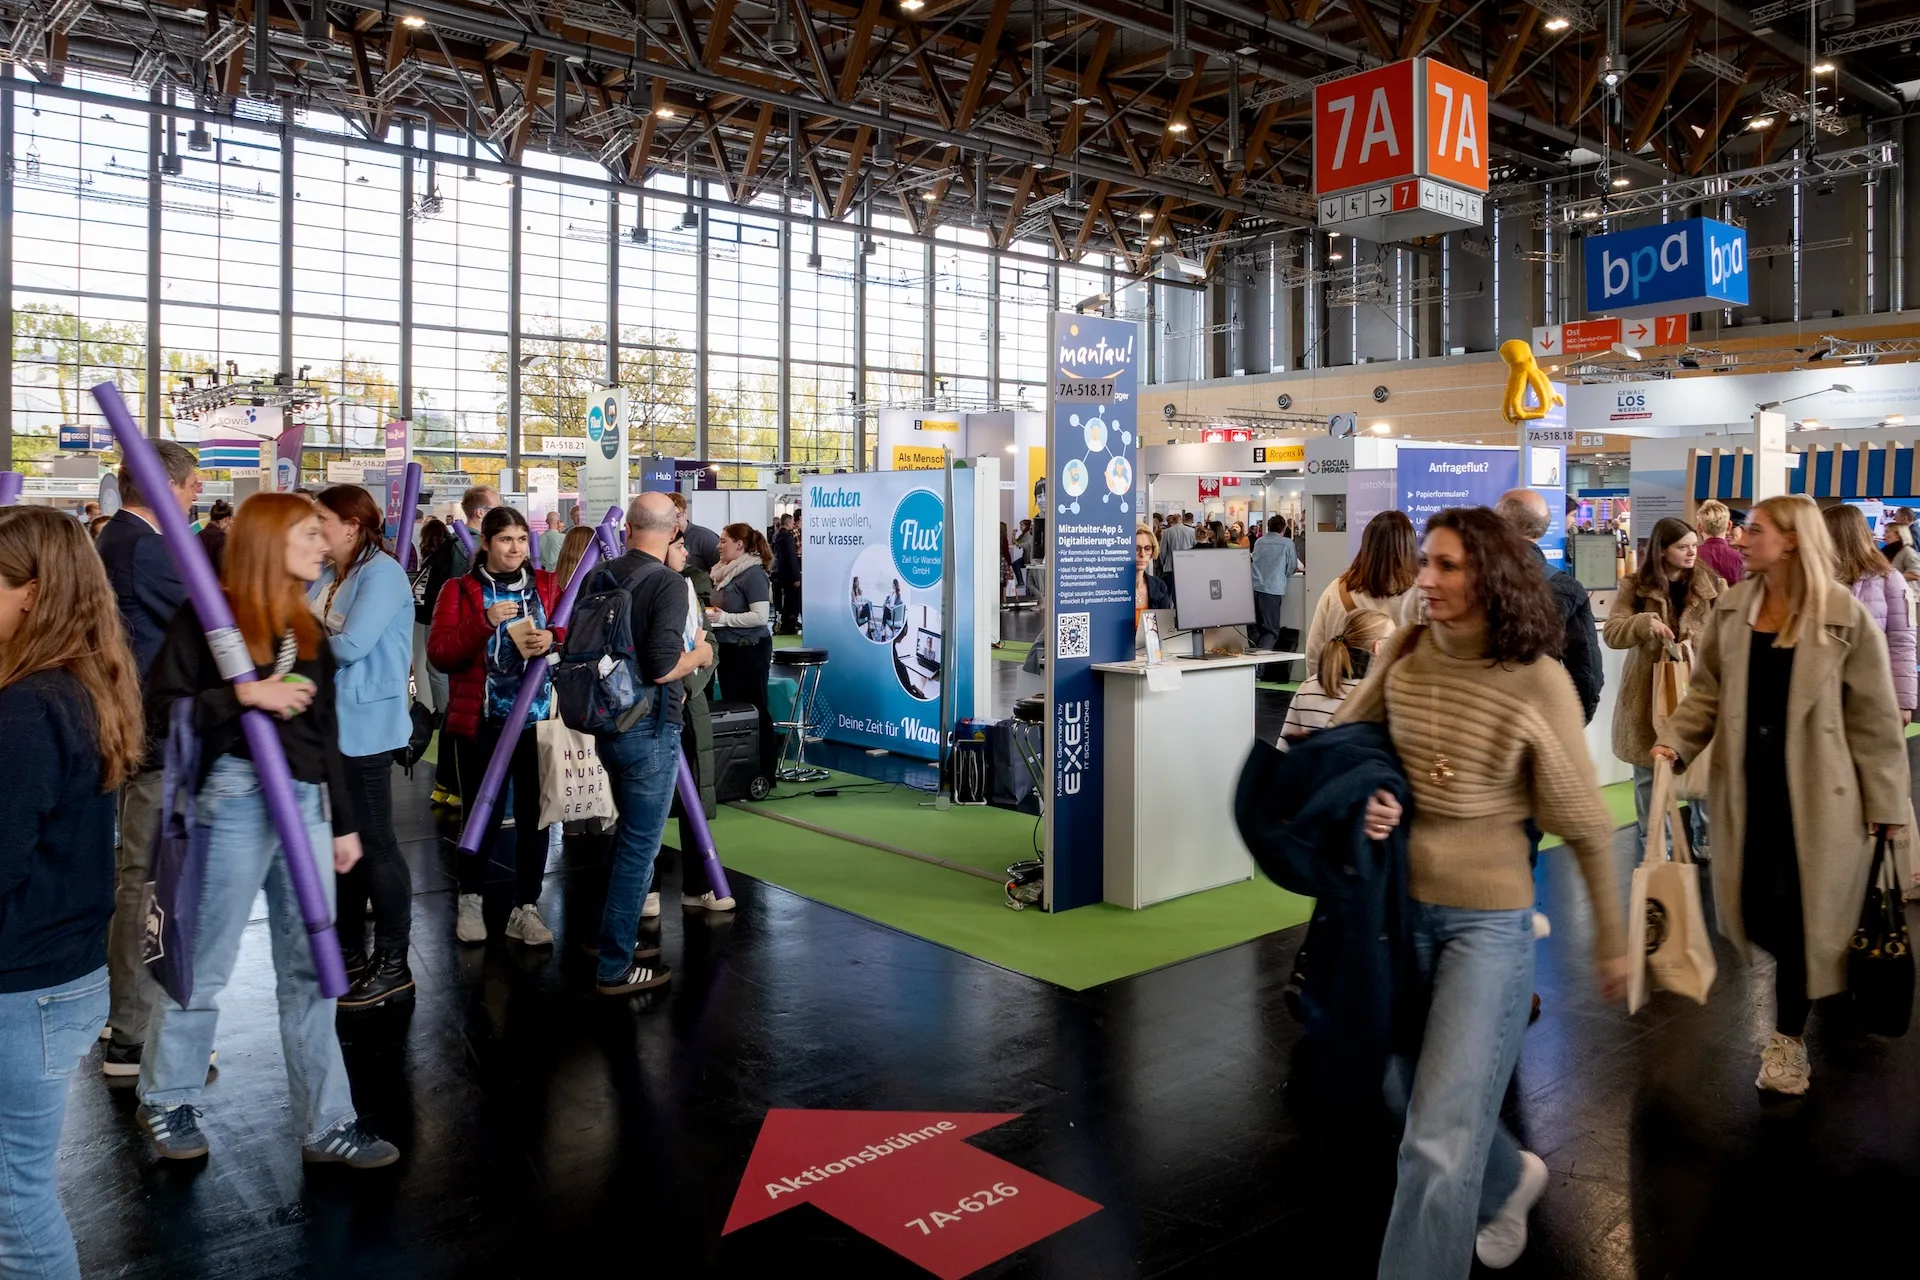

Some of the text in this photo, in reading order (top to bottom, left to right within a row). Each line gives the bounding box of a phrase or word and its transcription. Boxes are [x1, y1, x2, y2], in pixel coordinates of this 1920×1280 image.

[1328, 87, 1400, 170] 7A
[1435, 82, 1480, 168] 7A
[1401, 186, 1410, 206] 7
[1602, 230, 1688, 300] bpa
[1710, 236, 1742, 294] bpa
[1666, 317, 1677, 340] 7
[1060, 336, 1133, 366] mantau!
[1060, 384, 1113, 396] 7A-518.17
[1618, 396, 1645, 406] LOS
[1528, 432, 1574, 441] 7A-518.18
[544, 440, 584, 450] 7A-518.21
[898, 453, 945, 463] Als Mensch
[1270, 449, 1296, 460] Regens
[1429, 462, 1489, 474] Anfrageflut?
[656, 471, 672, 480] Hub
[810, 486, 860, 508] Machen
[1416, 490, 1469, 499] Papierformulare?
[1416, 504, 1440, 512] Analoge
[810, 513, 872, 529] ist wie wollen,
[900, 519, 942, 551] Flux
[1058, 524, 1123, 535] Mitarbeiter-App &
[810, 532, 864, 546] nur krasser.
[1058, 536, 1131, 547] Digitalisierungs-Tool
[902, 555, 912, 563] Zeit
[921, 556, 942, 564] Wandel
[912, 566, 930, 575] GmbH
[1057, 704, 1063, 714] by
[839, 714, 864, 731] Deine
[866, 718, 883, 734] Zeit
[885, 721, 899, 737] für
[1064, 702, 1082, 794] EXEC
[1057, 760, 1062, 768] in
[566, 765, 602, 778] NUNG
[564, 802, 592, 814] GER
[764, 1118, 958, 1200] Aktionsbühne
[904, 1181, 1020, 1236] 7A-626
